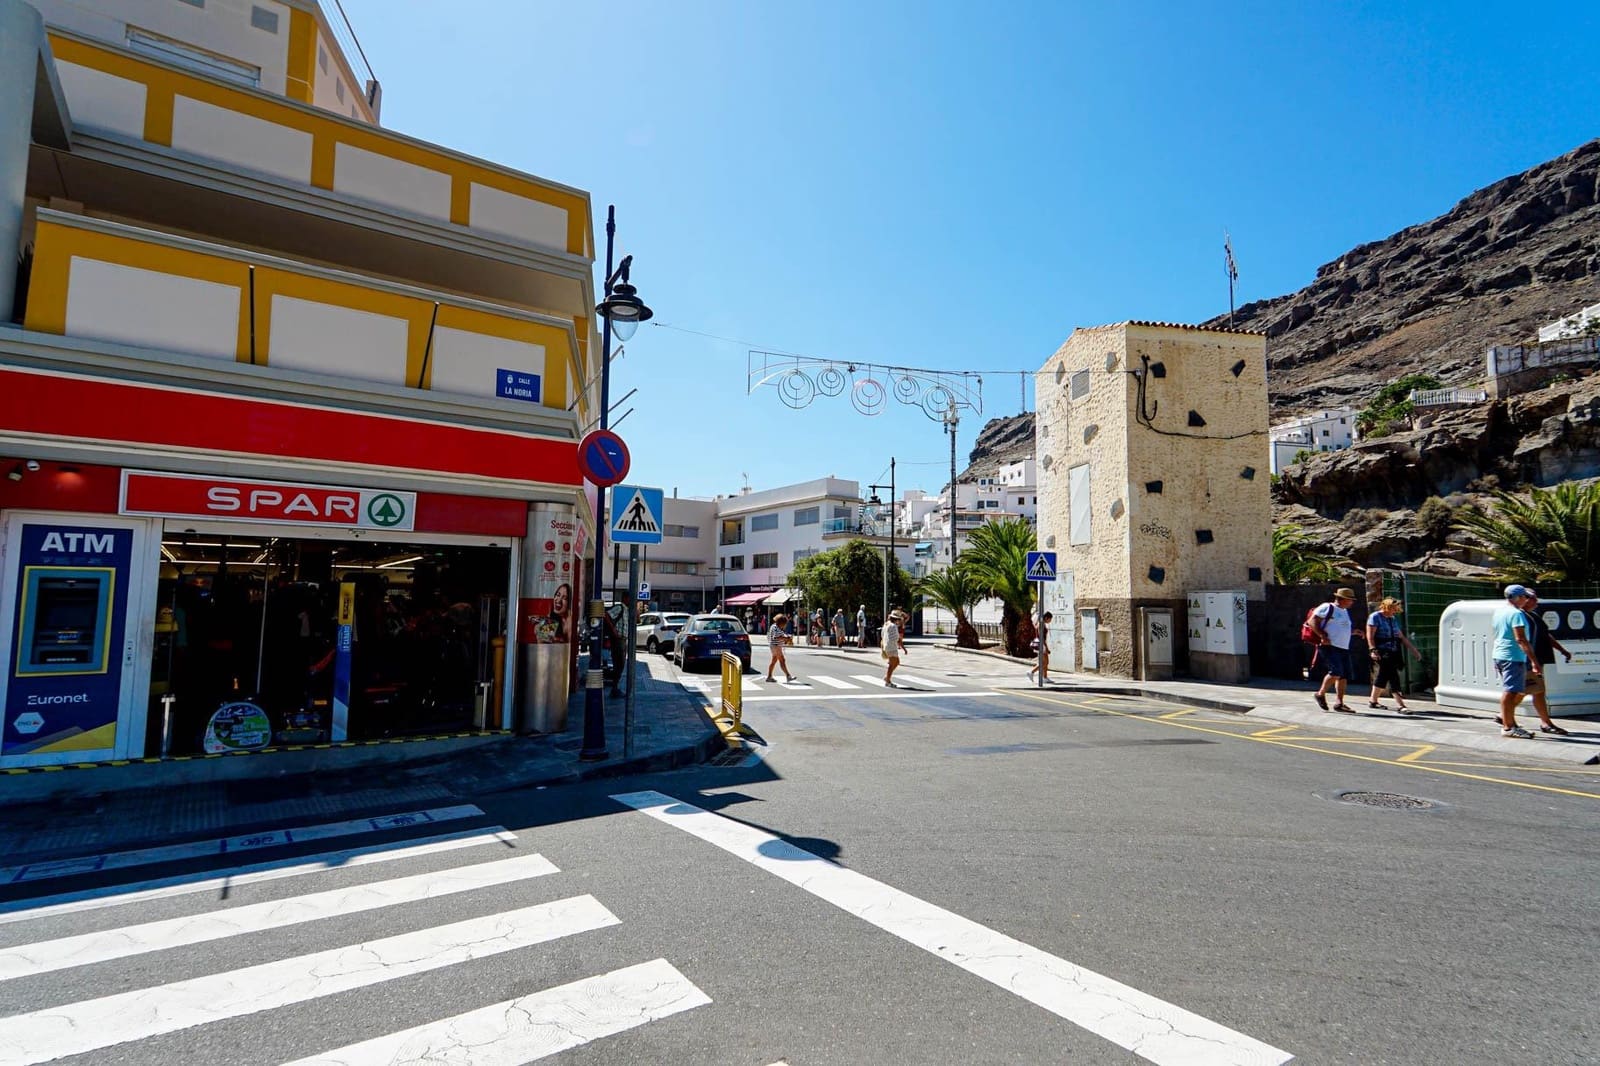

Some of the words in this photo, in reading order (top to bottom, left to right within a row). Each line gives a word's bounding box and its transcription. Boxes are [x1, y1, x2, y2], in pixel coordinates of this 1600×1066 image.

[505, 387, 512, 395] LA
[514, 388, 532, 397] NORIA
[207, 486, 356, 518] SPAR
[40, 531, 115, 554] ATM
[641, 583, 648, 591] P
[27, 692, 89, 705] Euronet
